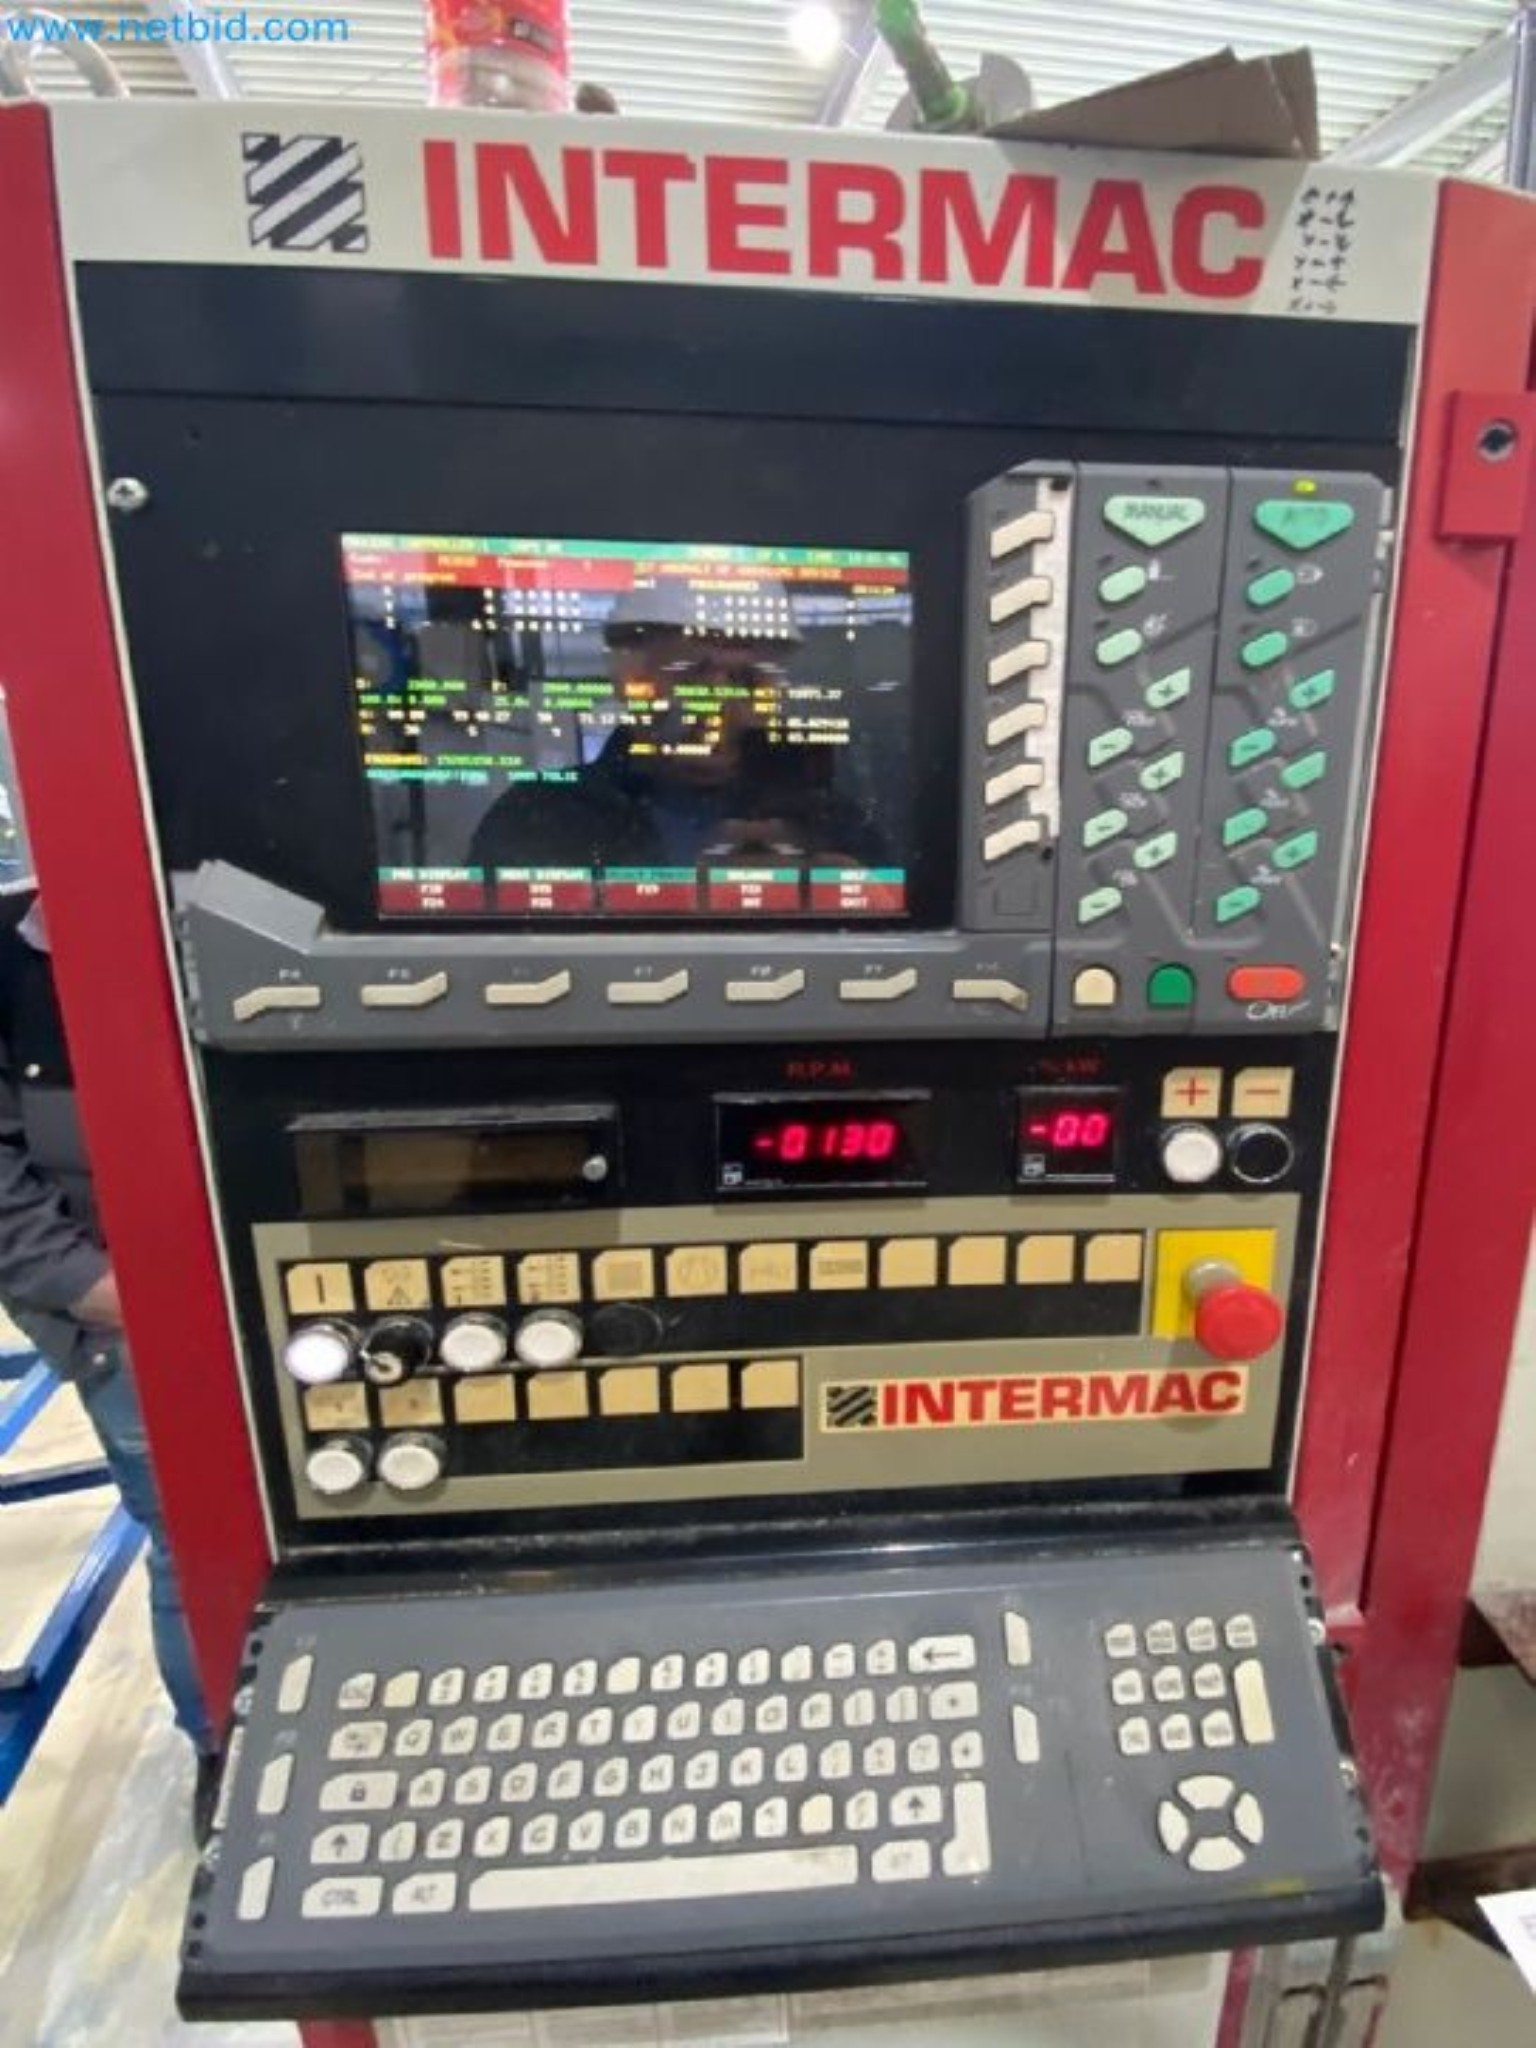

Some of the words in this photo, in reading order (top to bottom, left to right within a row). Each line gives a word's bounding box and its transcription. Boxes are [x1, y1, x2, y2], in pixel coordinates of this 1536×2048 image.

[423, 139, 1264, 300] INTERMAC
[755, 1124, 895, 1160] -0130
[1030, 1114, 1108, 1147] -00
[883, 1371, 1240, 1425] INTERMAC
